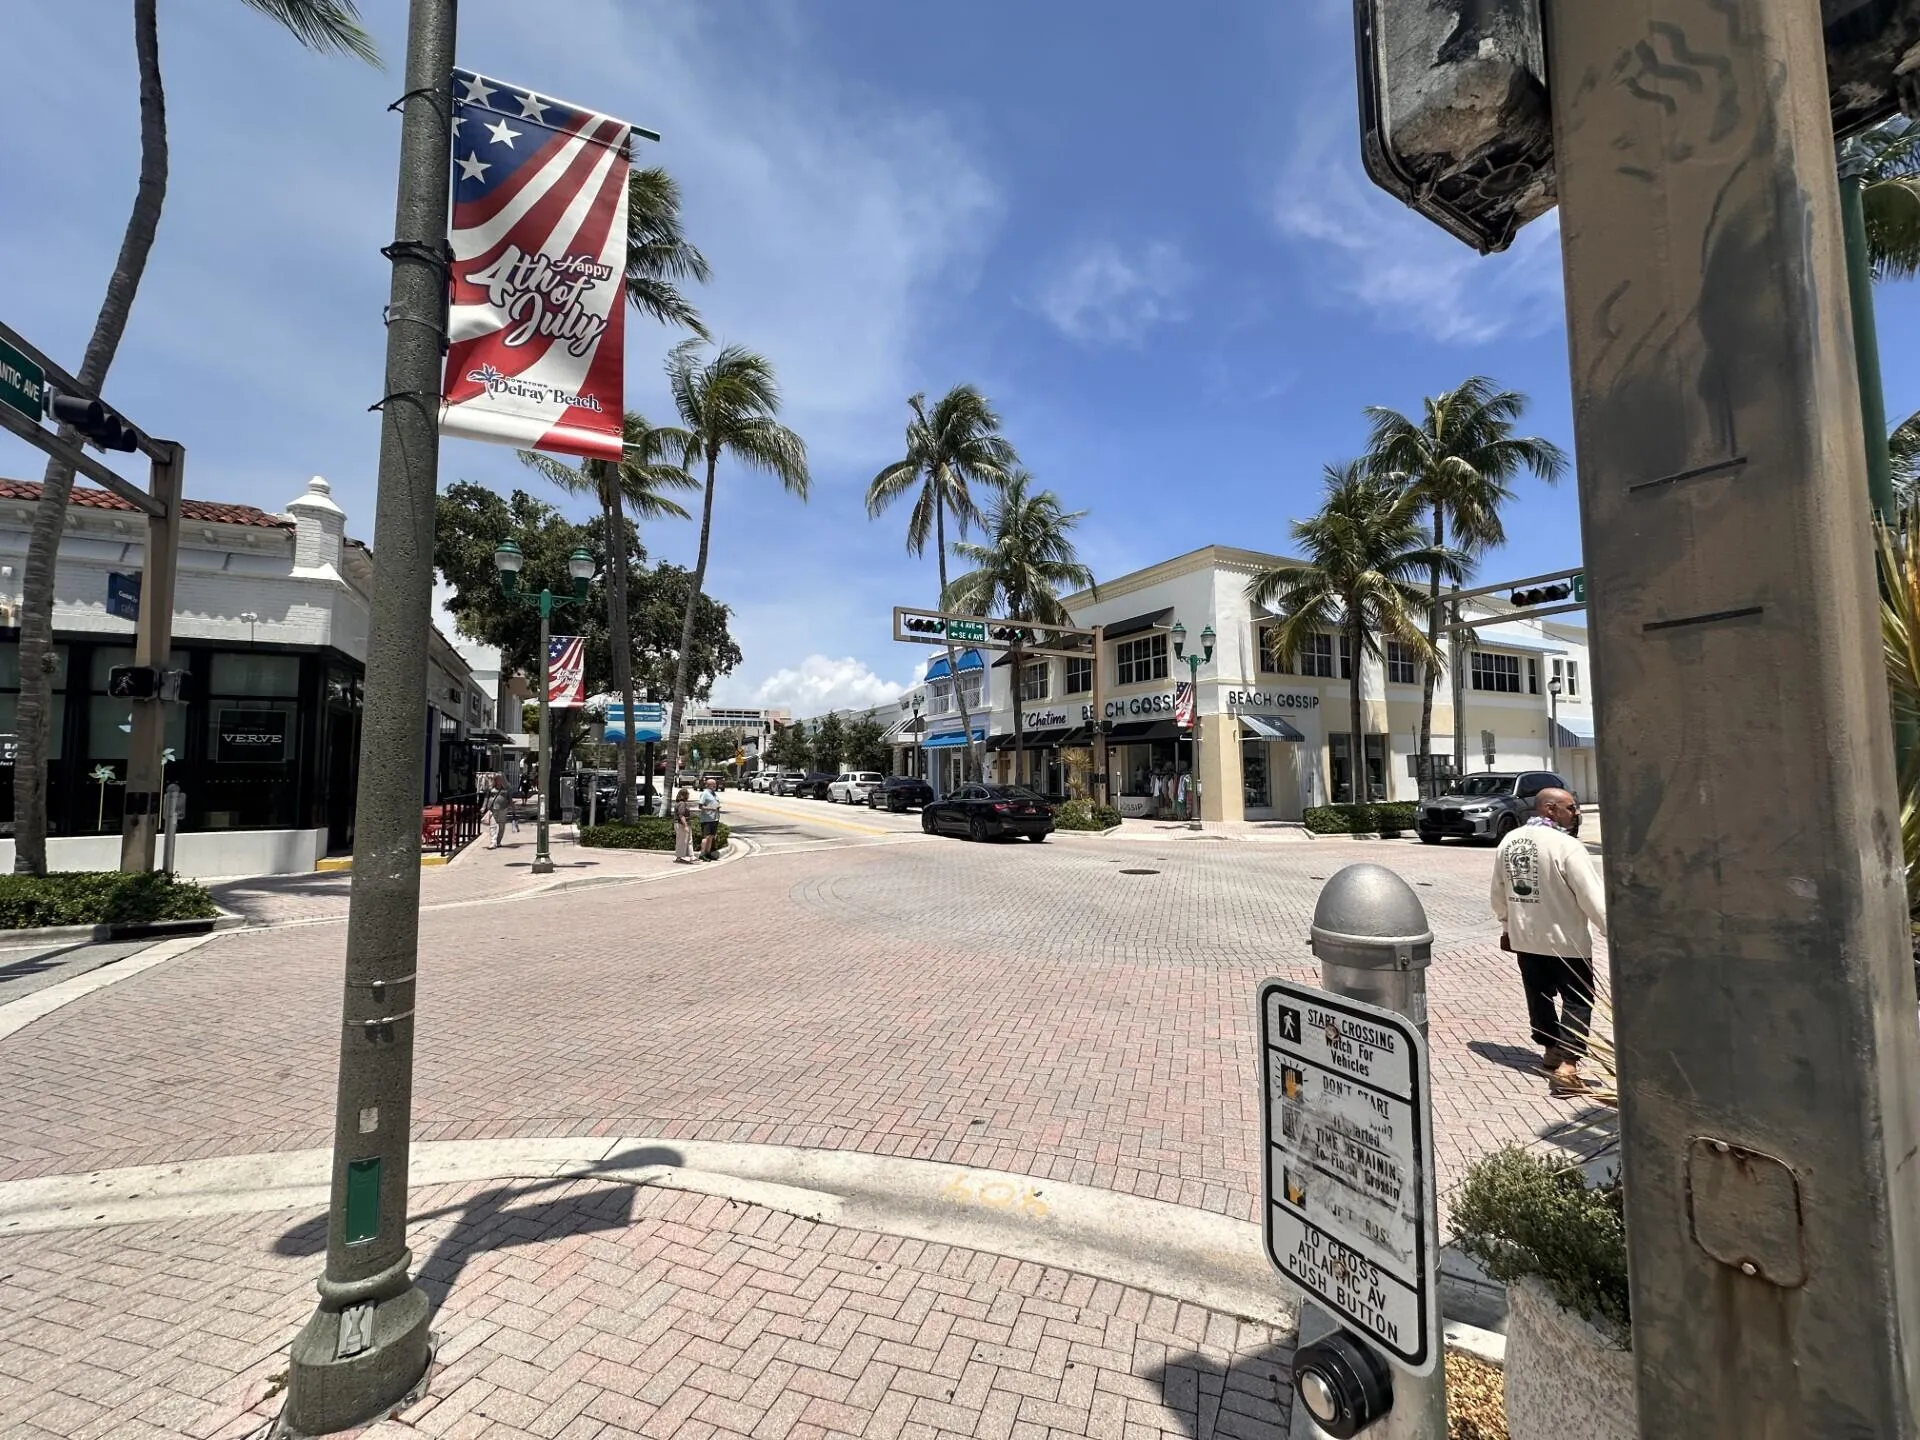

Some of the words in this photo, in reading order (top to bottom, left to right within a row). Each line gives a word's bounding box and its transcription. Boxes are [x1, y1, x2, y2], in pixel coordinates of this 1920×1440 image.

[464, 243, 560, 307] 4th
[549, 275, 596, 314] of
[550, 255, 611, 280] Happy
[503, 290, 608, 357] July
[23, 378, 40, 402] AVE
[490, 378, 553, 405] Delray
[553, 389, 602, 412] Beach
[950, 620, 959, 628] NE
[965, 622, 976, 630] AVE
[958, 631, 966, 639] SE
[973, 633, 984, 641] AVE
[1081, 701, 1125, 721] BECH
[1229, 690, 1272, 707] BEACH
[1277, 693, 1320, 709] GOSSIP
[1028, 710, 1066, 728] Chatime
[222, 732, 282, 743] VERVE
[1511, 837, 1533, 847] BOYS
[1341, 1019, 1394, 1050] CROSSING
[1330, 1048, 1370, 1077] Vehicles
[1358, 1043, 1374, 1062] For
[1322, 1075, 1352, 1097] DON'T
[1316, 1127, 1339, 1151] TIME
[1303, 1223, 1320, 1249] TO
[1328, 1241, 1379, 1288] CROSS
[1289, 1252, 1328, 1293] PUSH
[1336, 1285, 1398, 1345] BUTTON
[1367, 1285, 1387, 1311] AV
